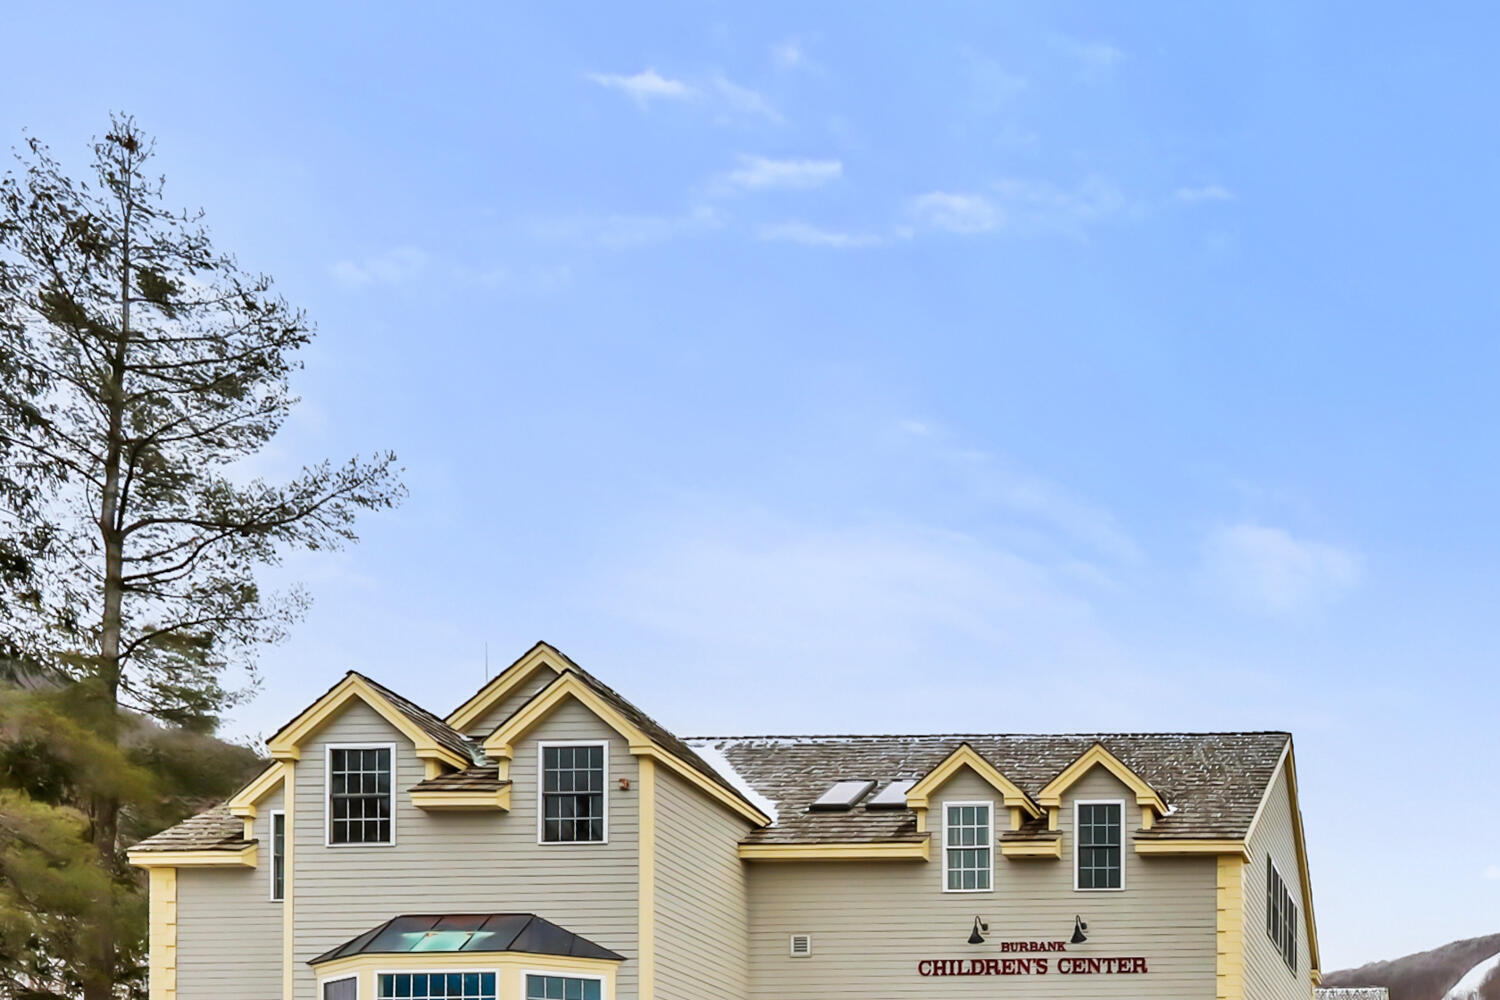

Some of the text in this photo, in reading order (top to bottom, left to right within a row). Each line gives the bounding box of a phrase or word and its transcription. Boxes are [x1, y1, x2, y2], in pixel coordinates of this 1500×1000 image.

[1001, 941, 1066, 952] BURBANK
[918, 957, 1148, 976] CHILDREN'S CENTER
